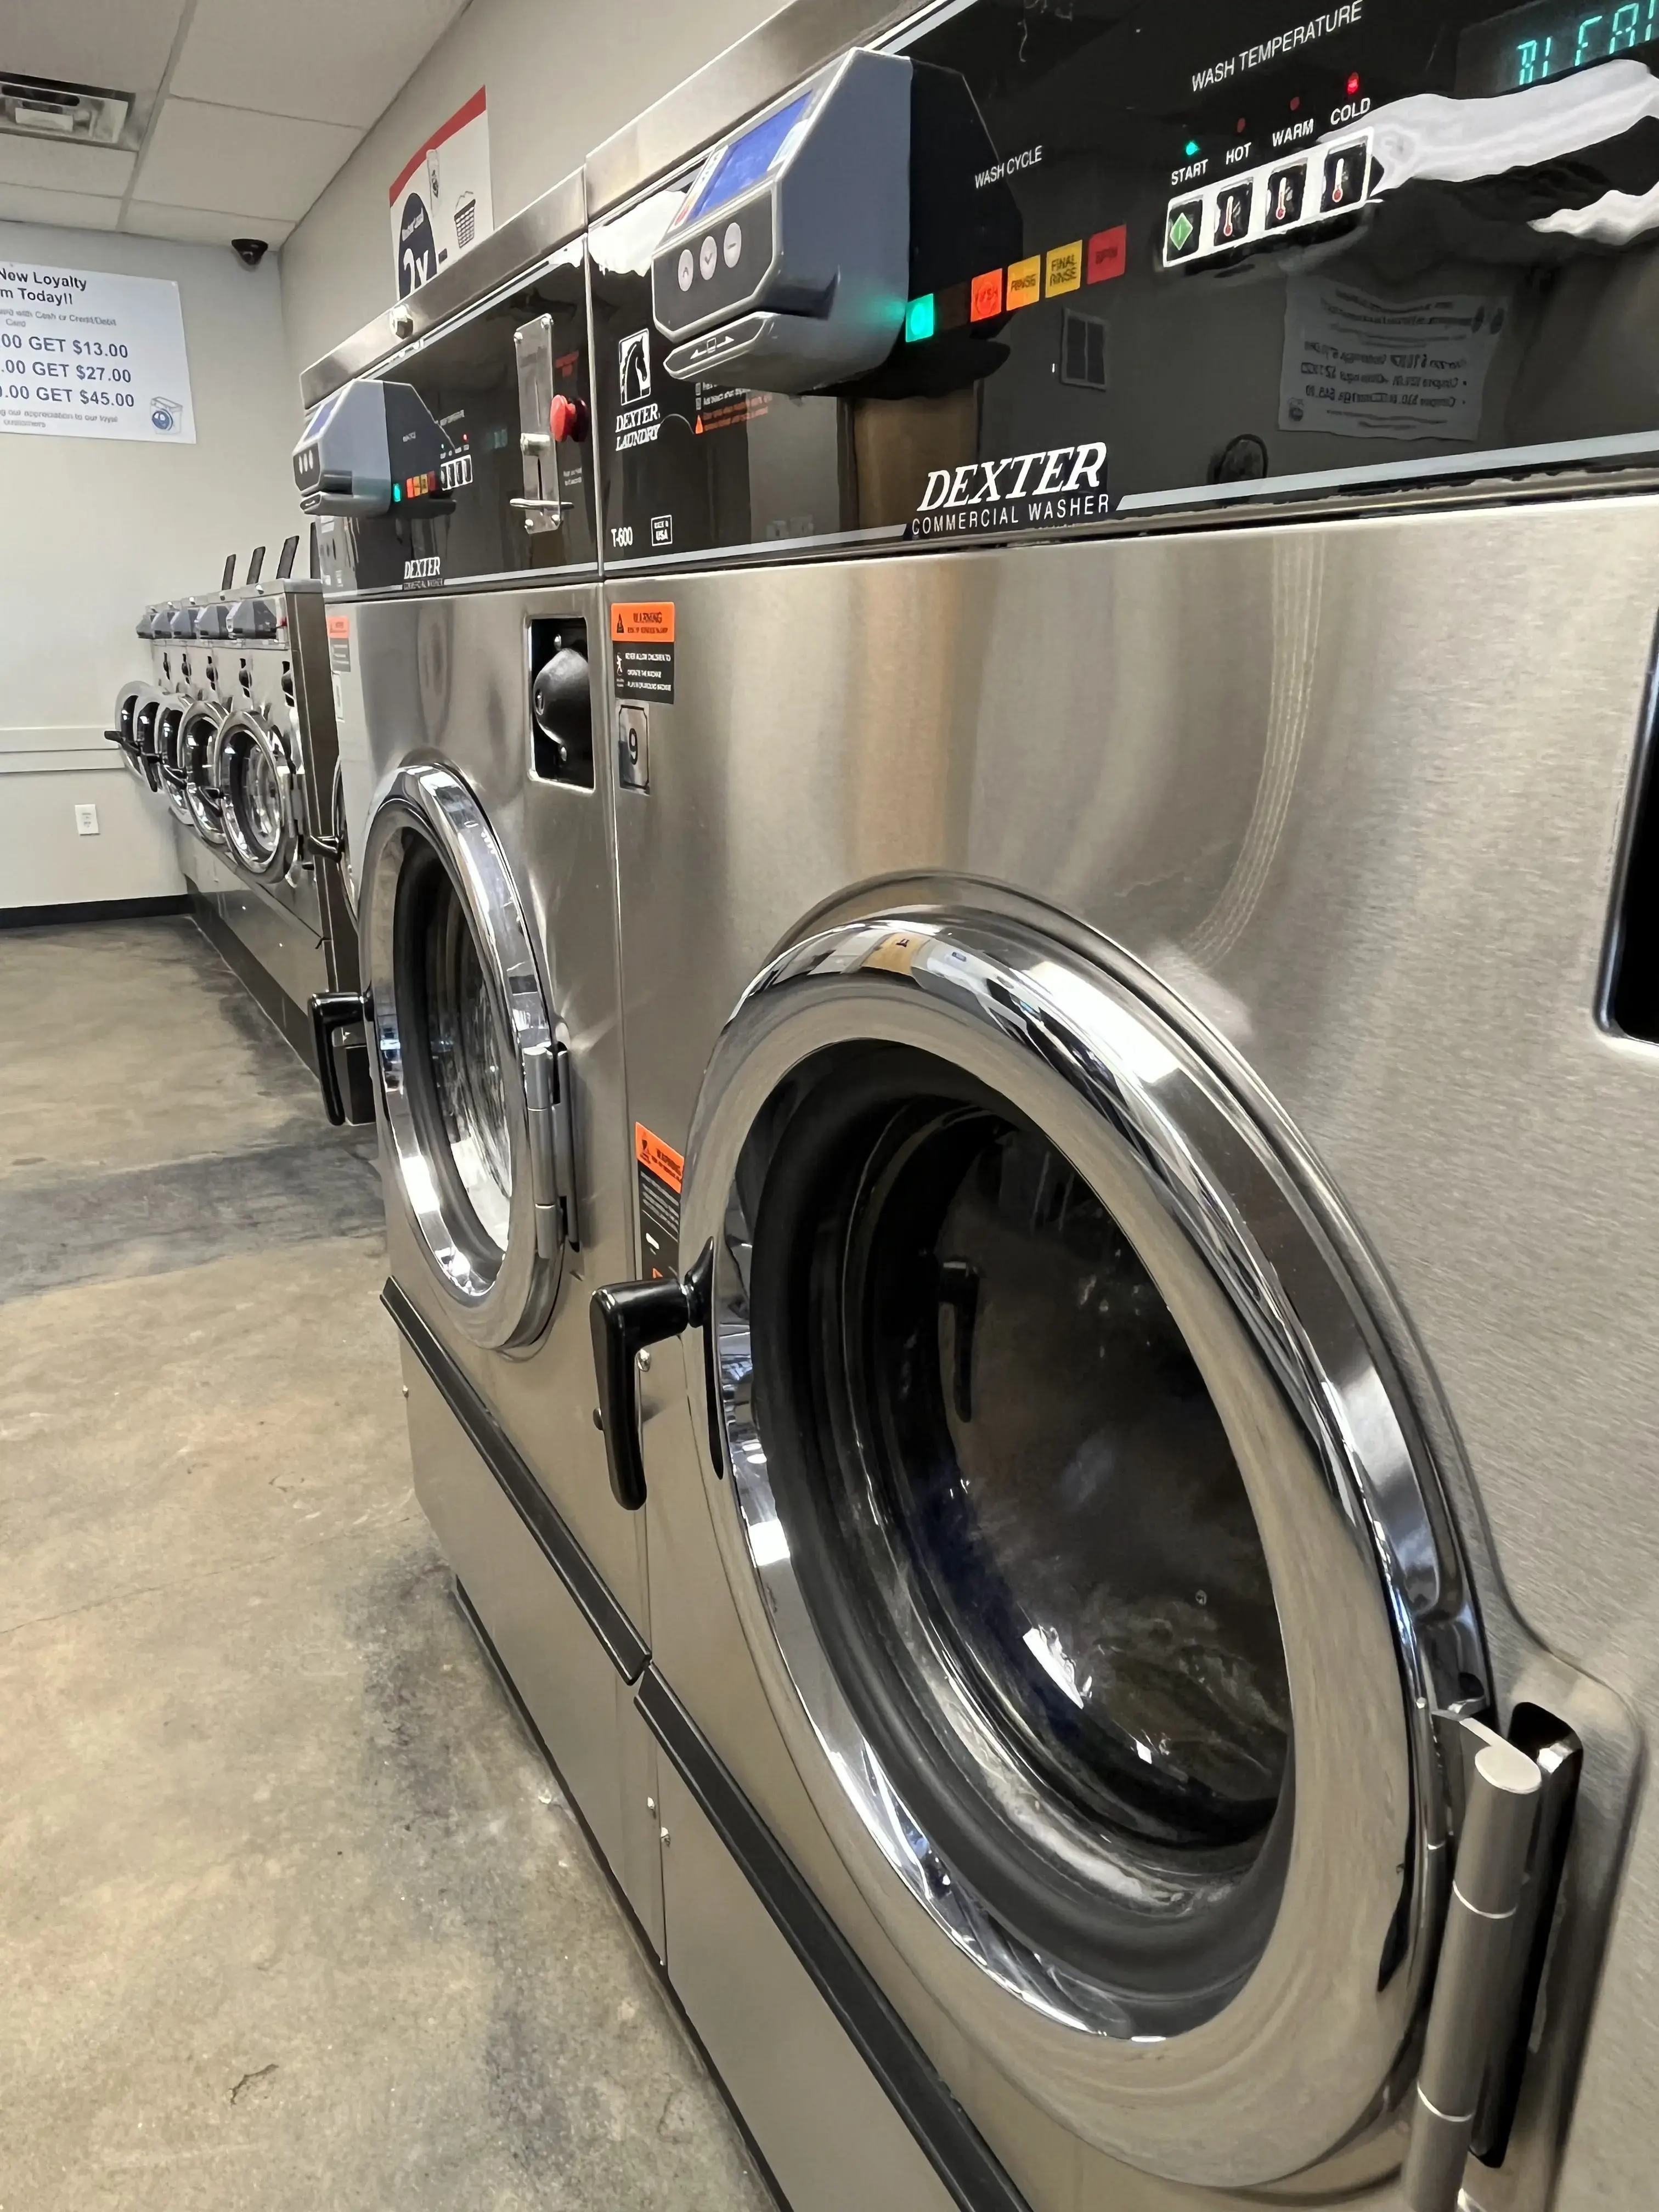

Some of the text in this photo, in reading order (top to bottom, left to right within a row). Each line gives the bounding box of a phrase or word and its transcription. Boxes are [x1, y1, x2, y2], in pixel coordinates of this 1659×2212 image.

[1192, 0, 1363, 92] WASH TEMPERATURE
[1330, 98, 1371, 126] COLD
[1272, 119, 1314, 147] WARM
[1226, 142, 1251, 165] HOT
[974, 145, 1042, 189] WASH CYCLE
[1171, 159, 1209, 185] START
[1051, 253, 1077, 272] FINAL
[33, 272, 86, 291] Loyalty
[1049, 267, 1077, 287] RINSE
[18, 287, 73, 306] Today!!
[0, 334, 128, 358] 00 GET $13.00
[1, 359, 131, 382] .00 GET $27.00
[36, 387, 72, 402] GET
[80, 390, 134, 407] $45.00
[615, 403, 661, 433] DEXTER
[615, 423, 661, 452] LAUNDRY
[917, 442, 1107, 511] DEXTER
[912, 493, 1109, 535] COMMERCIAL WASHER
[611, 526, 633, 548] T-600
[404, 556, 441, 580] DEXTER
